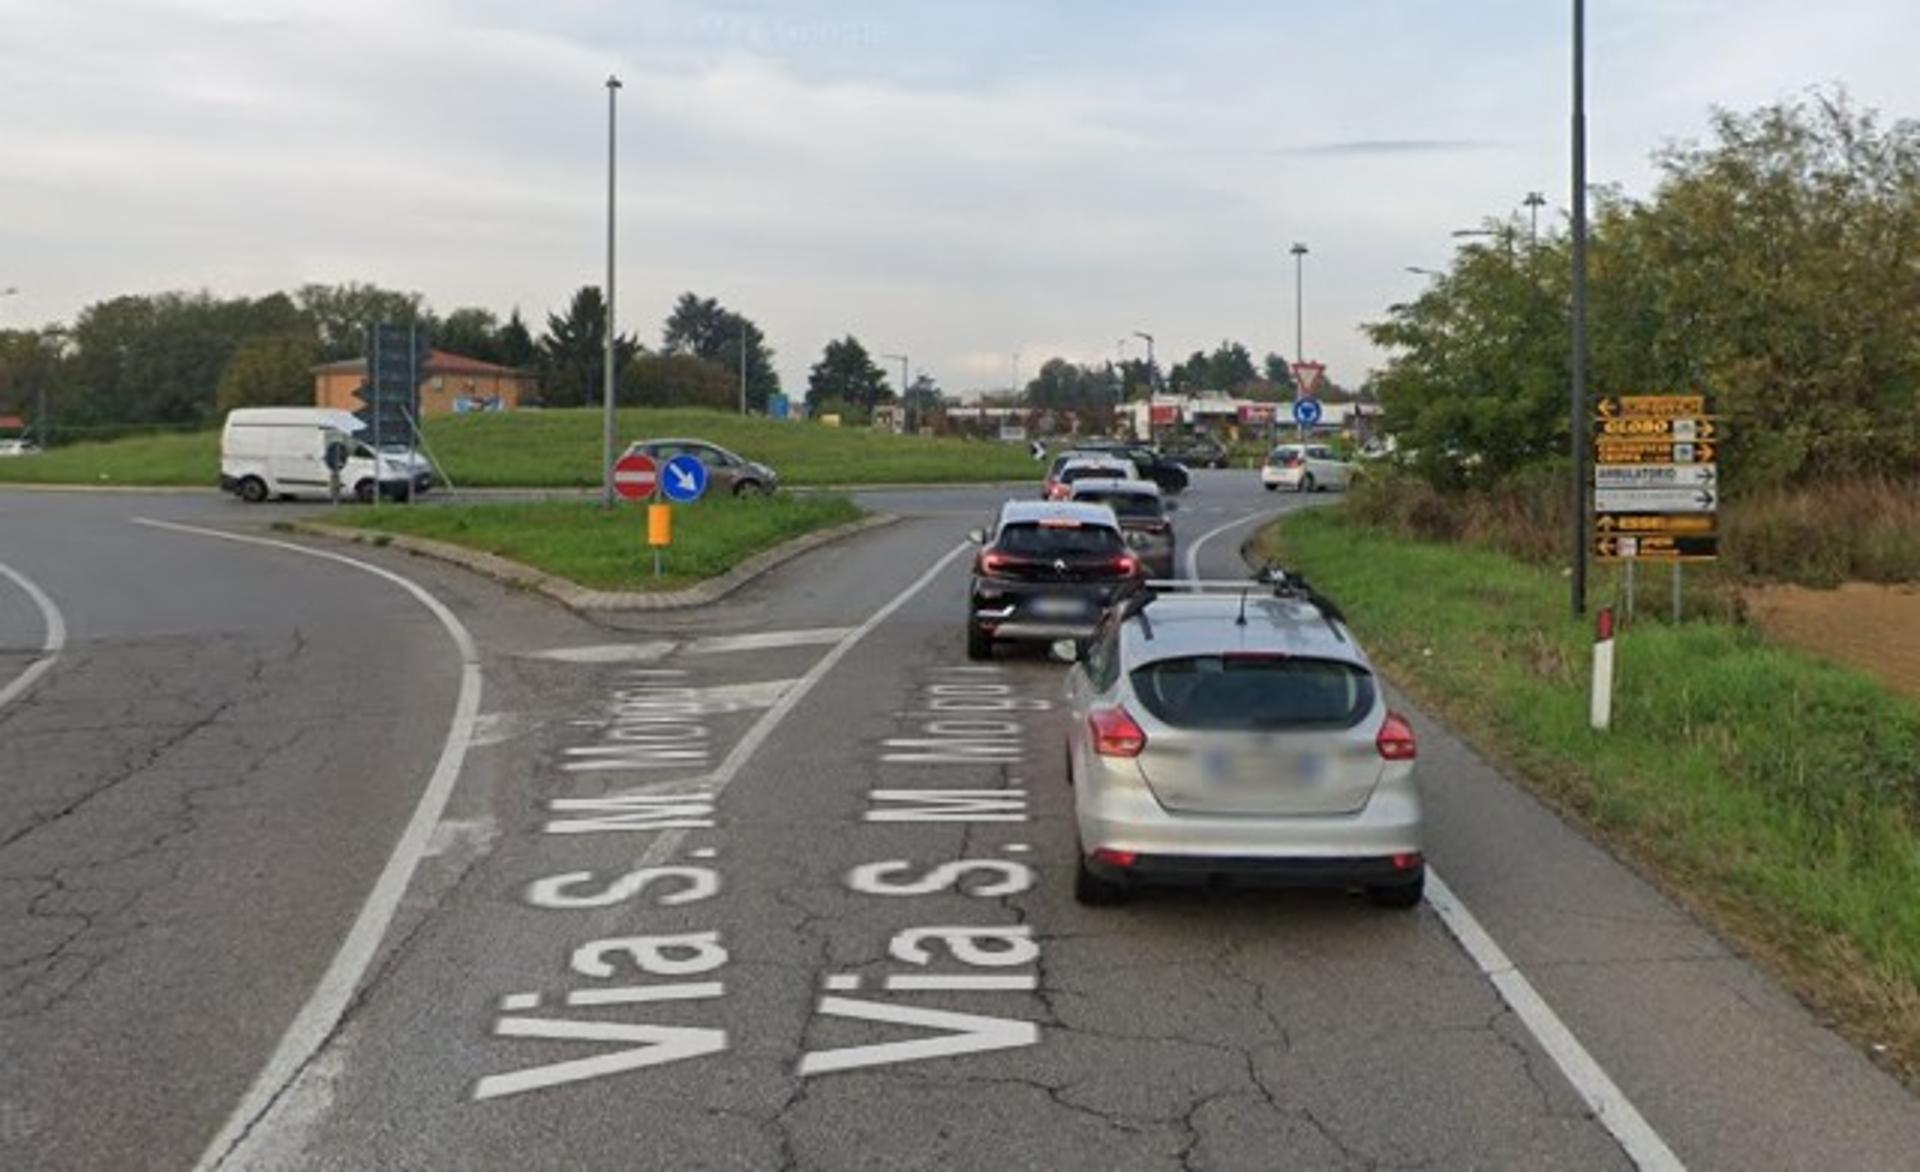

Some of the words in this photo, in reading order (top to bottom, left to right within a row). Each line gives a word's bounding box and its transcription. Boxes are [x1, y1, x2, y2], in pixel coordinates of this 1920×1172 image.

[526, 847, 721, 908] S.
[845, 843, 1036, 897] S.
[472, 929, 730, 1101] Via
[798, 924, 1041, 1077] Via
